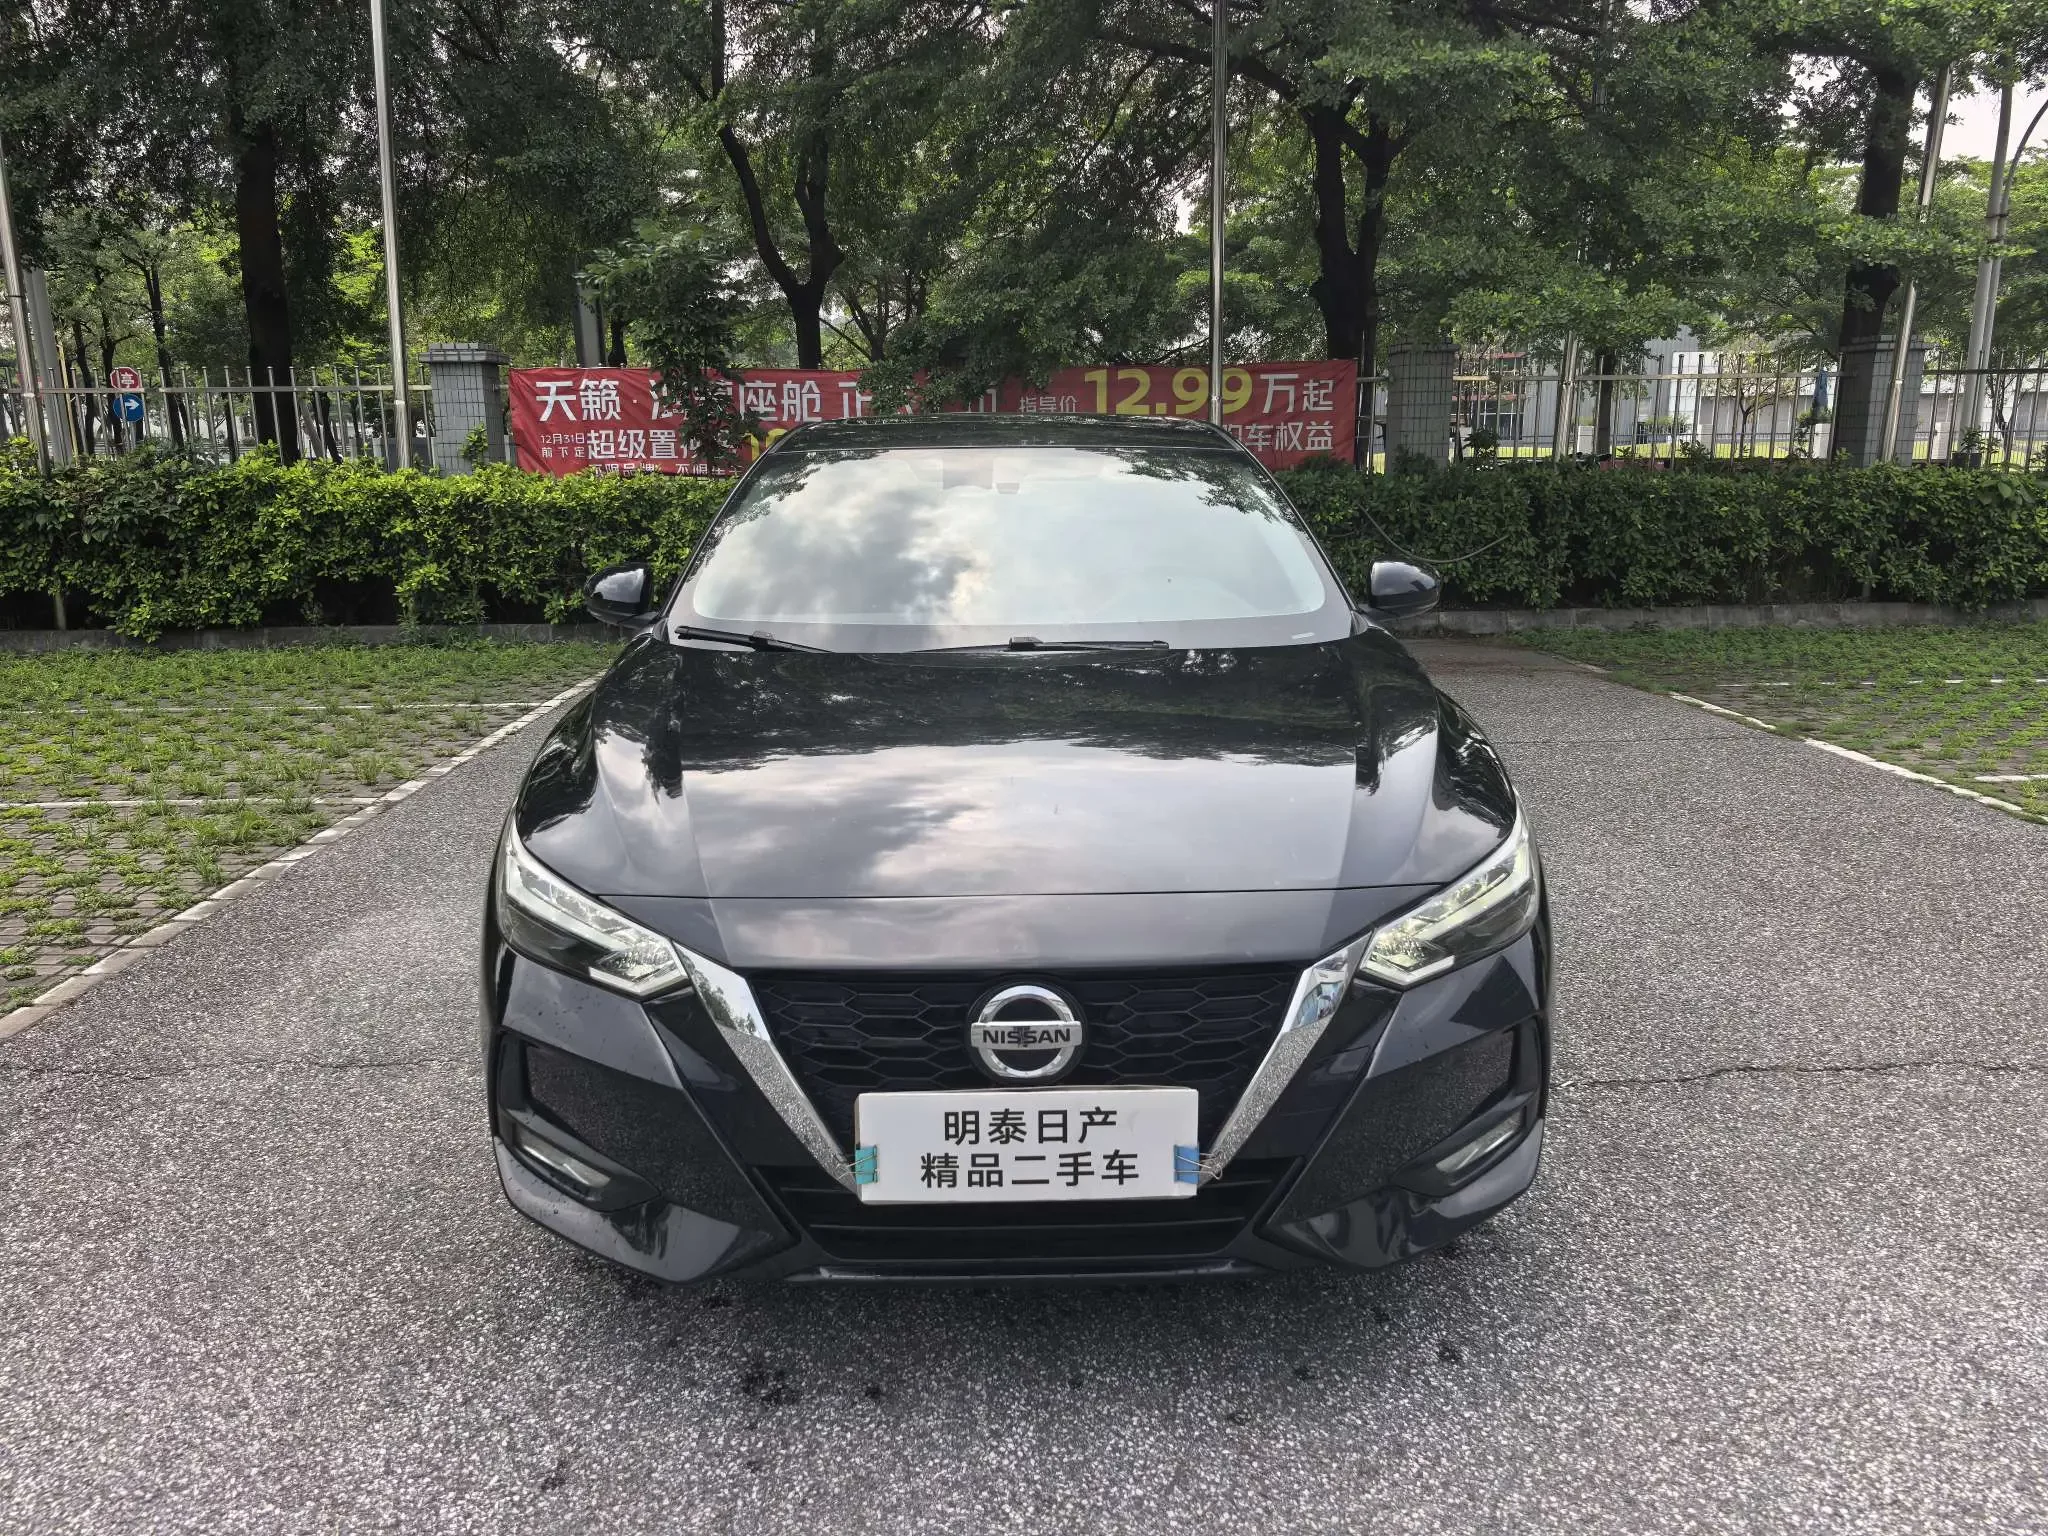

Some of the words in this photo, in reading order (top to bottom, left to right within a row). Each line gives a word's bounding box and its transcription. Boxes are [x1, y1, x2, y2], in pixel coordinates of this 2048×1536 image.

[540, 433, 584, 444] 12月31日
[982, 1027, 1071, 1044] NISSAN
[943, 1106, 1118, 1146] 明泰日产
[919, 1148, 1140, 1189] 精品二手车
